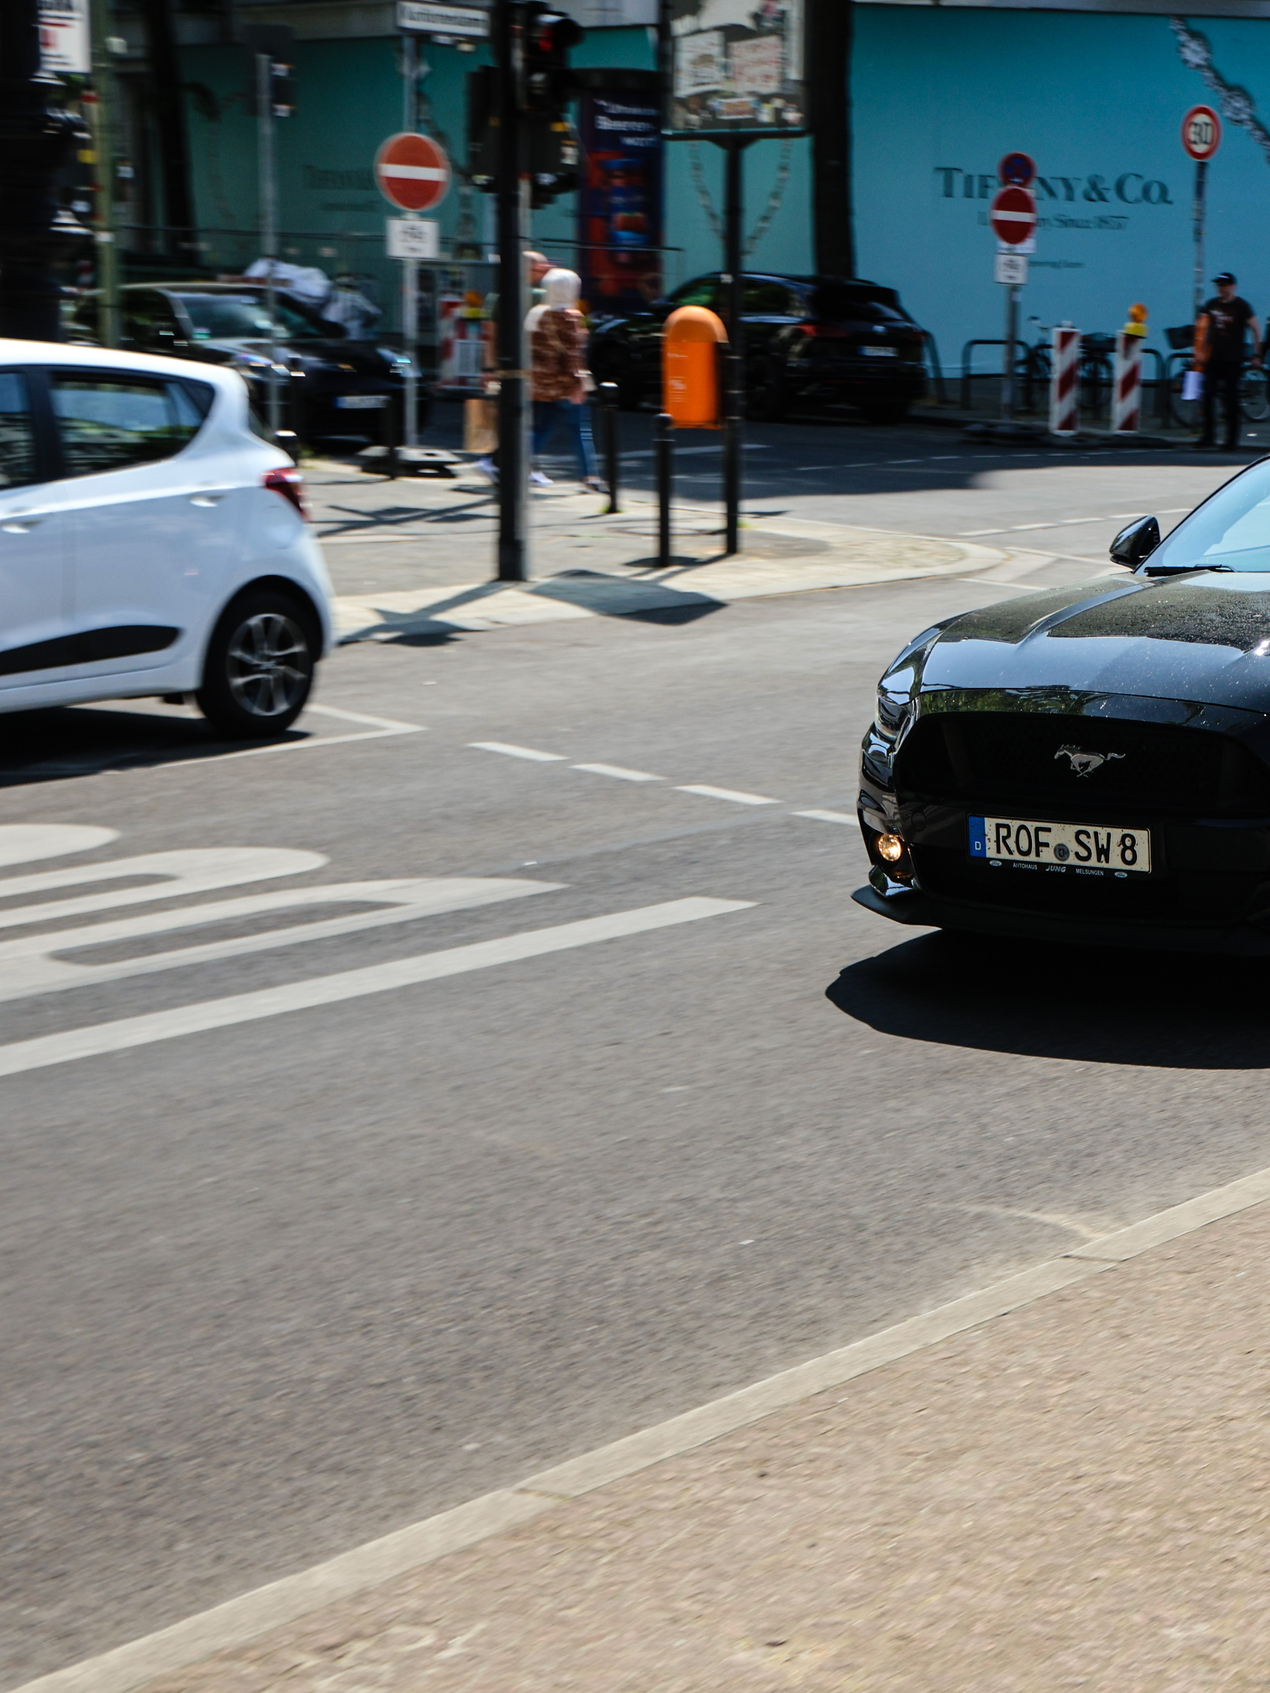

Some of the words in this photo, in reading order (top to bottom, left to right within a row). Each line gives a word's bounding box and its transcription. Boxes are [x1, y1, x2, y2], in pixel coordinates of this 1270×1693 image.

[974, 841, 982, 850] D
[995, 823, 1052, 857] ROF
[1074, 829, 1111, 864] SW
[1120, 833, 1138, 866] 8
[1012, 862, 1038, 870] AUTOHAUS
[1045, 864, 1067, 873] JUNG
[1075, 868, 1104, 876] MELSUNGEN
